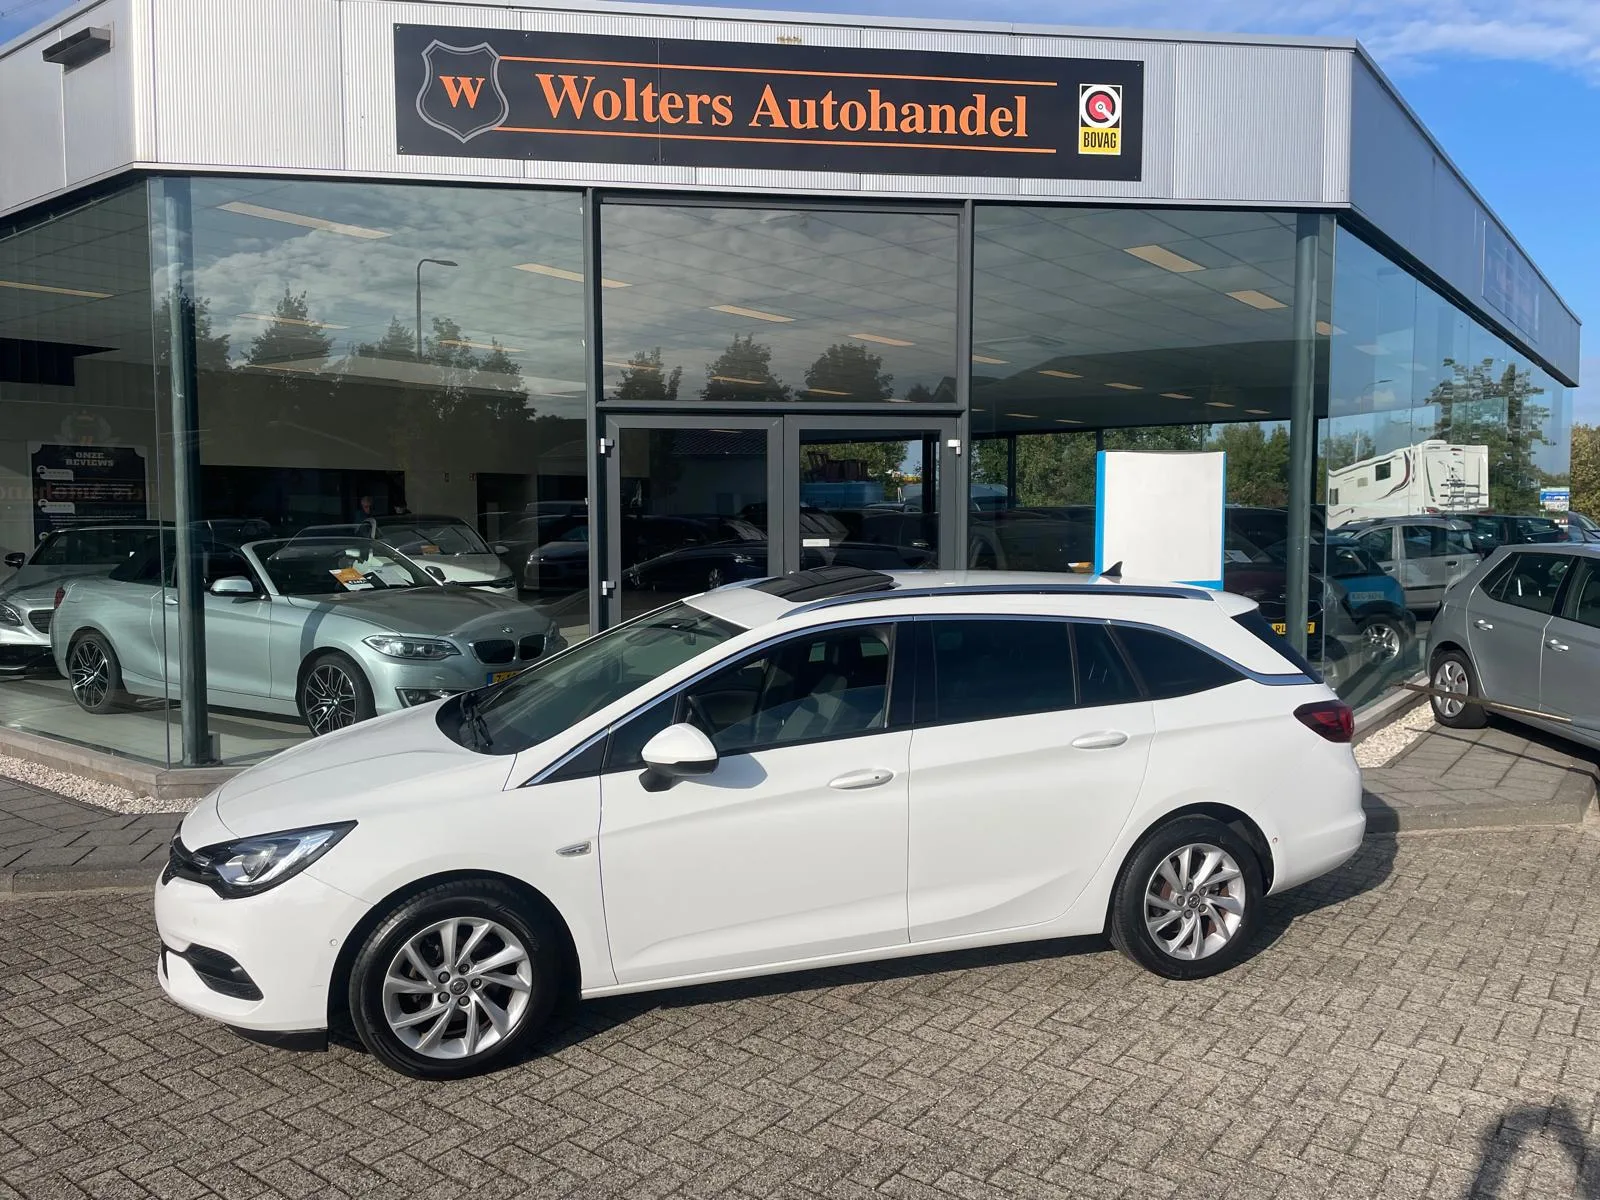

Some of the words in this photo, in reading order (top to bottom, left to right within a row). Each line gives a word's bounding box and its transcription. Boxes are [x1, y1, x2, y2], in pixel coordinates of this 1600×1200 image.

[439, 75, 486, 109] W
[535, 73, 734, 126] Wolters
[748, 83, 1029, 137] Autohandel
[1083, 131, 1117, 149] BOVAG
[64, 458, 114, 467] REVIEWS
[75, 451, 104, 459] ONZE
